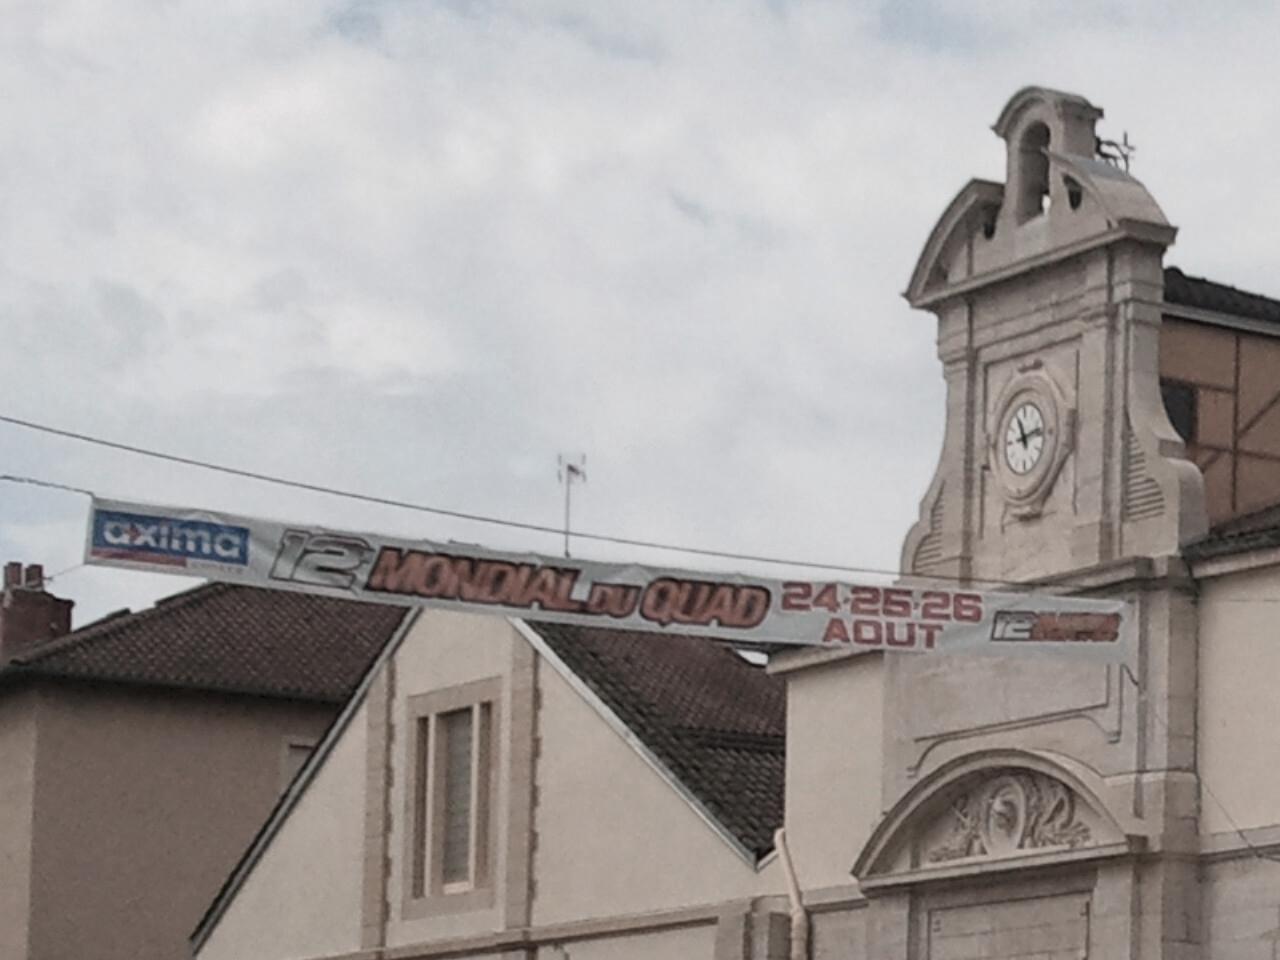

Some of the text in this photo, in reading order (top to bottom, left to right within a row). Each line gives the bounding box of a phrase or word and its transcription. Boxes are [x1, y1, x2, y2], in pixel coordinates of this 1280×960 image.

[103, 520, 241, 558] axima
[269, 528, 772, 632] 12 MONDIAL DU QUAD
[821, 617, 944, 649] AOUT
